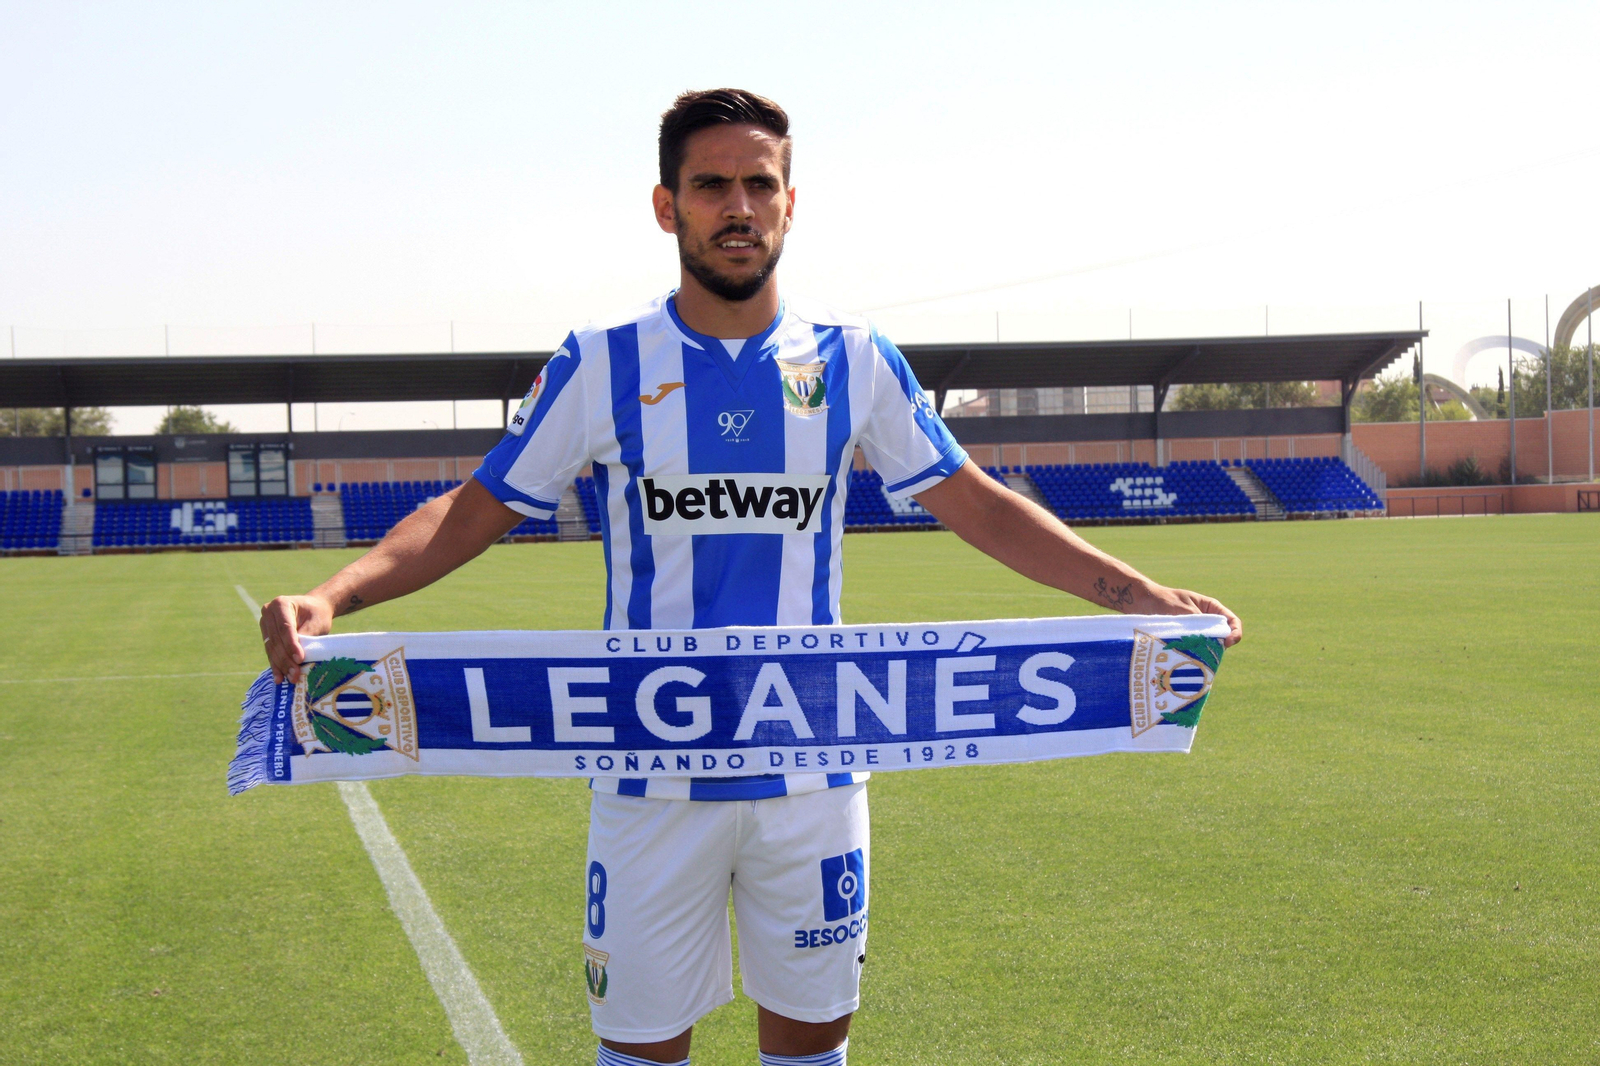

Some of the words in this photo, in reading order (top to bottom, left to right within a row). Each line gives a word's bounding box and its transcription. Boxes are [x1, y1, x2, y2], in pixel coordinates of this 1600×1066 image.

[643, 478, 824, 531] betway
[606, 636, 698, 652] CLUB
[726, 631, 939, 651] DEPORTIVO
[1134, 636, 1149, 700] DEPORTIVO
[389, 656, 405, 685] CLUB
[463, 631, 1077, 744] LEGANÉS
[395, 686, 413, 753] DEPORTIVO
[1135, 702, 1146, 728] CLUB
[274, 723, 284, 777] PEPINERO
[575, 752, 745, 771] SOÑANDO
[769, 749, 879, 767] DESDE
[903, 743, 979, 763] 1928
[588, 861, 607, 939] 8
